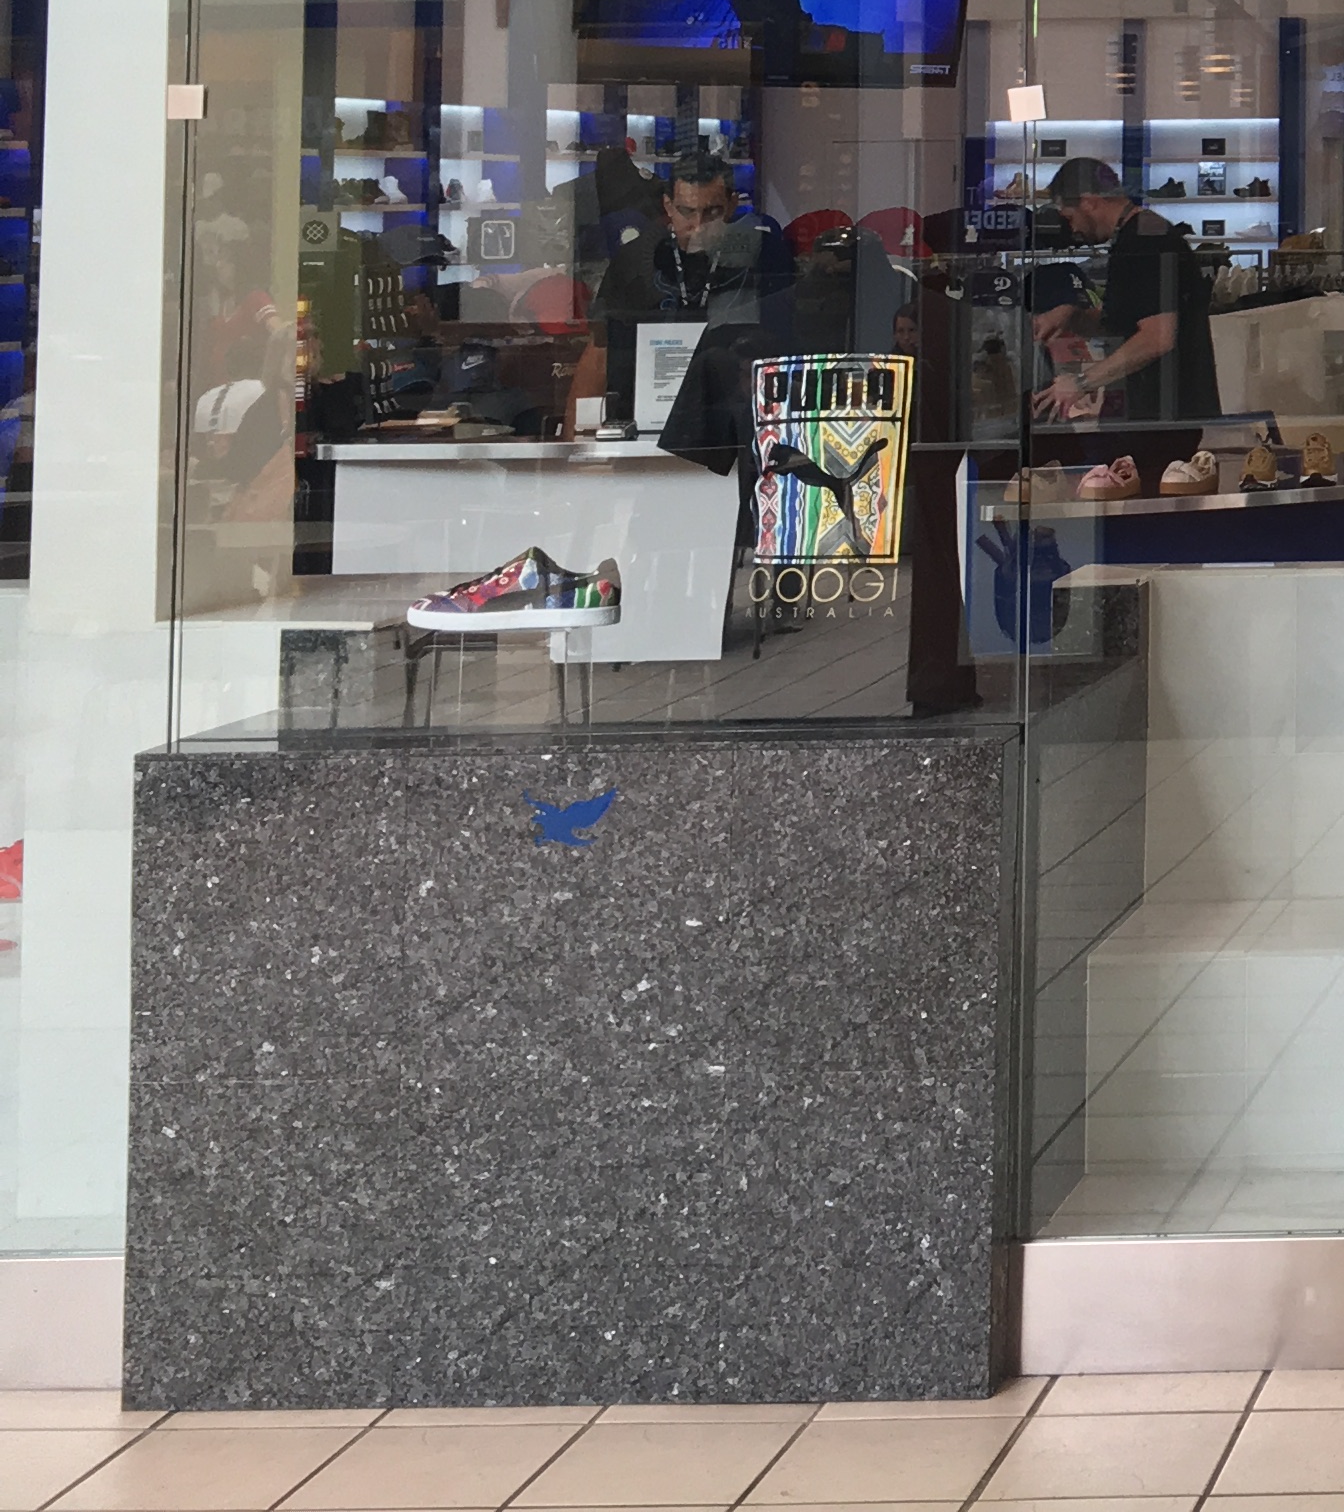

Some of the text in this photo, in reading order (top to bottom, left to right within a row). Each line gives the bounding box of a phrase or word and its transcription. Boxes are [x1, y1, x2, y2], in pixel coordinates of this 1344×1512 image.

[765, 369, 896, 414] PUMA
[749, 567, 899, 602] COOGI
[745, 606, 894, 619] AUSTRALIA
